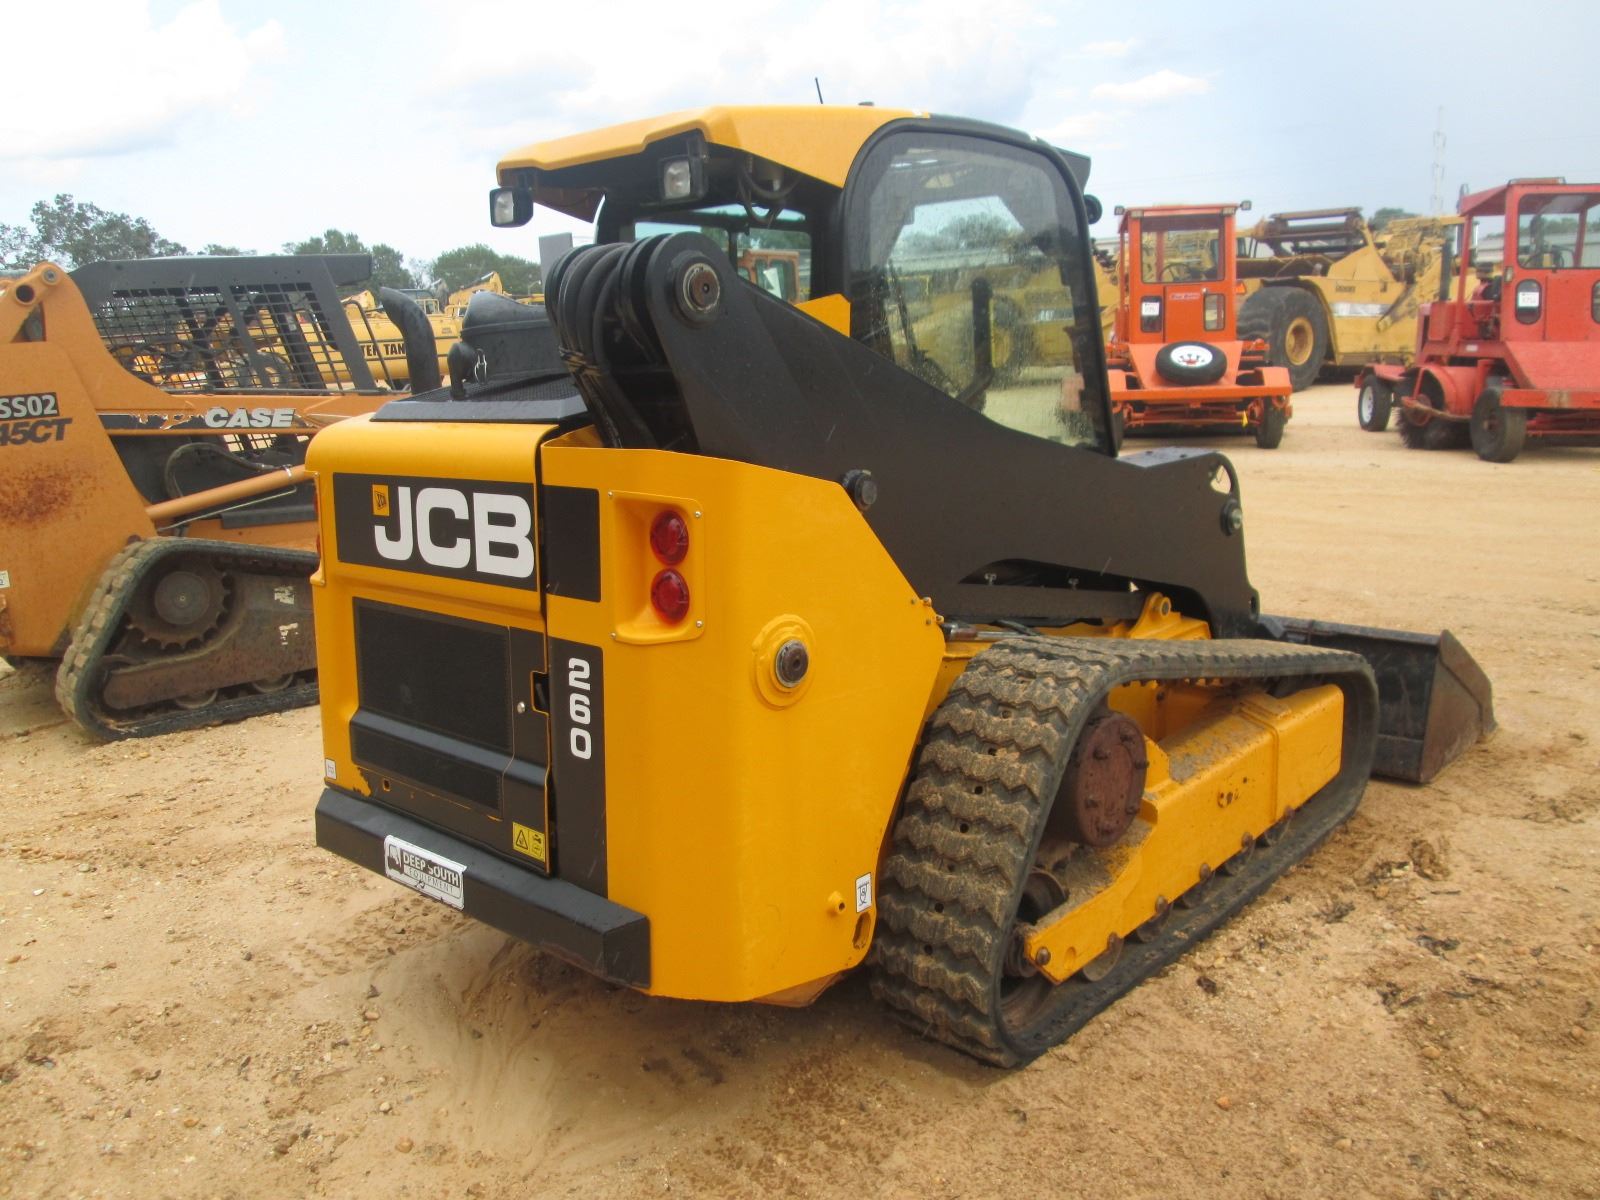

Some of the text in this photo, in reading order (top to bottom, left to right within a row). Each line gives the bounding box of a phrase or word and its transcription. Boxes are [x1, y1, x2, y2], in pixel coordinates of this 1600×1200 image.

[205, 407, 295, 428] CASE
[374, 486, 535, 578] JCB
[568, 657, 592, 760] 260
[403, 852, 459, 887] DEEP SOUTH
[408, 867, 454, 893] EQUIPMENT
